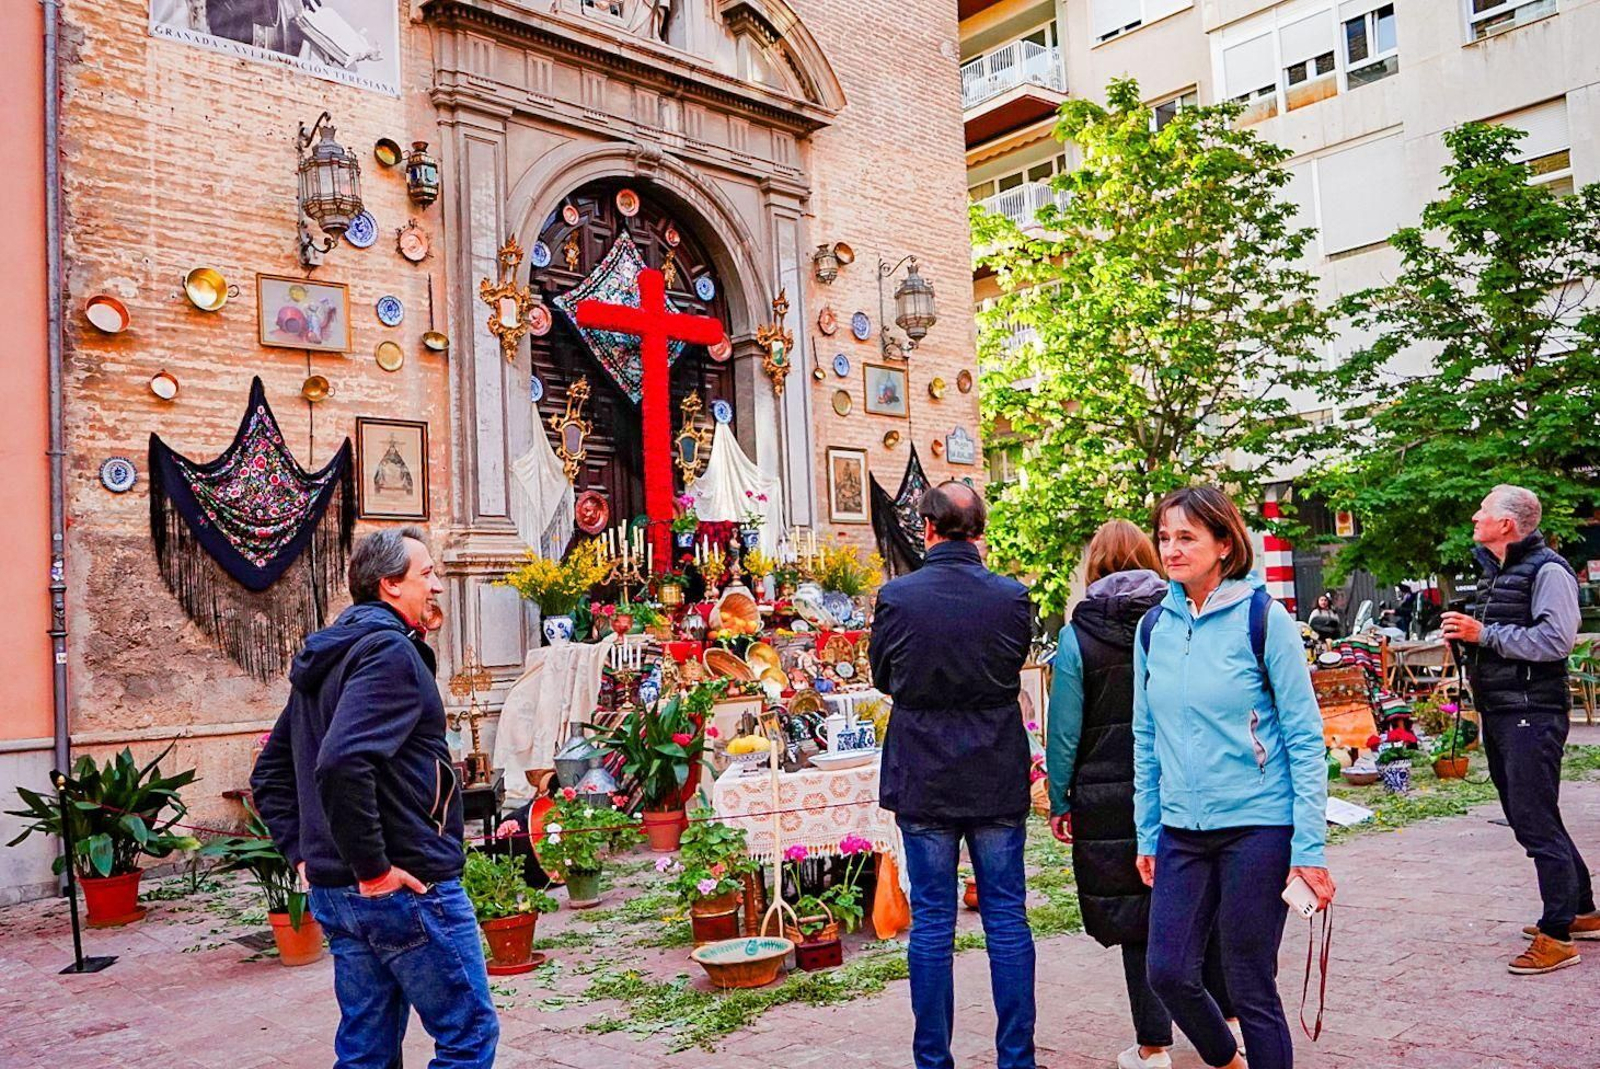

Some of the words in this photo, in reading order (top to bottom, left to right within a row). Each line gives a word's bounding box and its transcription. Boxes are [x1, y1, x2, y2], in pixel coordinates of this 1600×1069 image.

[155, 25, 218, 48] GRANADA
[233, 44, 254, 57] XVI
[334, 71, 396, 95] TERESIANA
